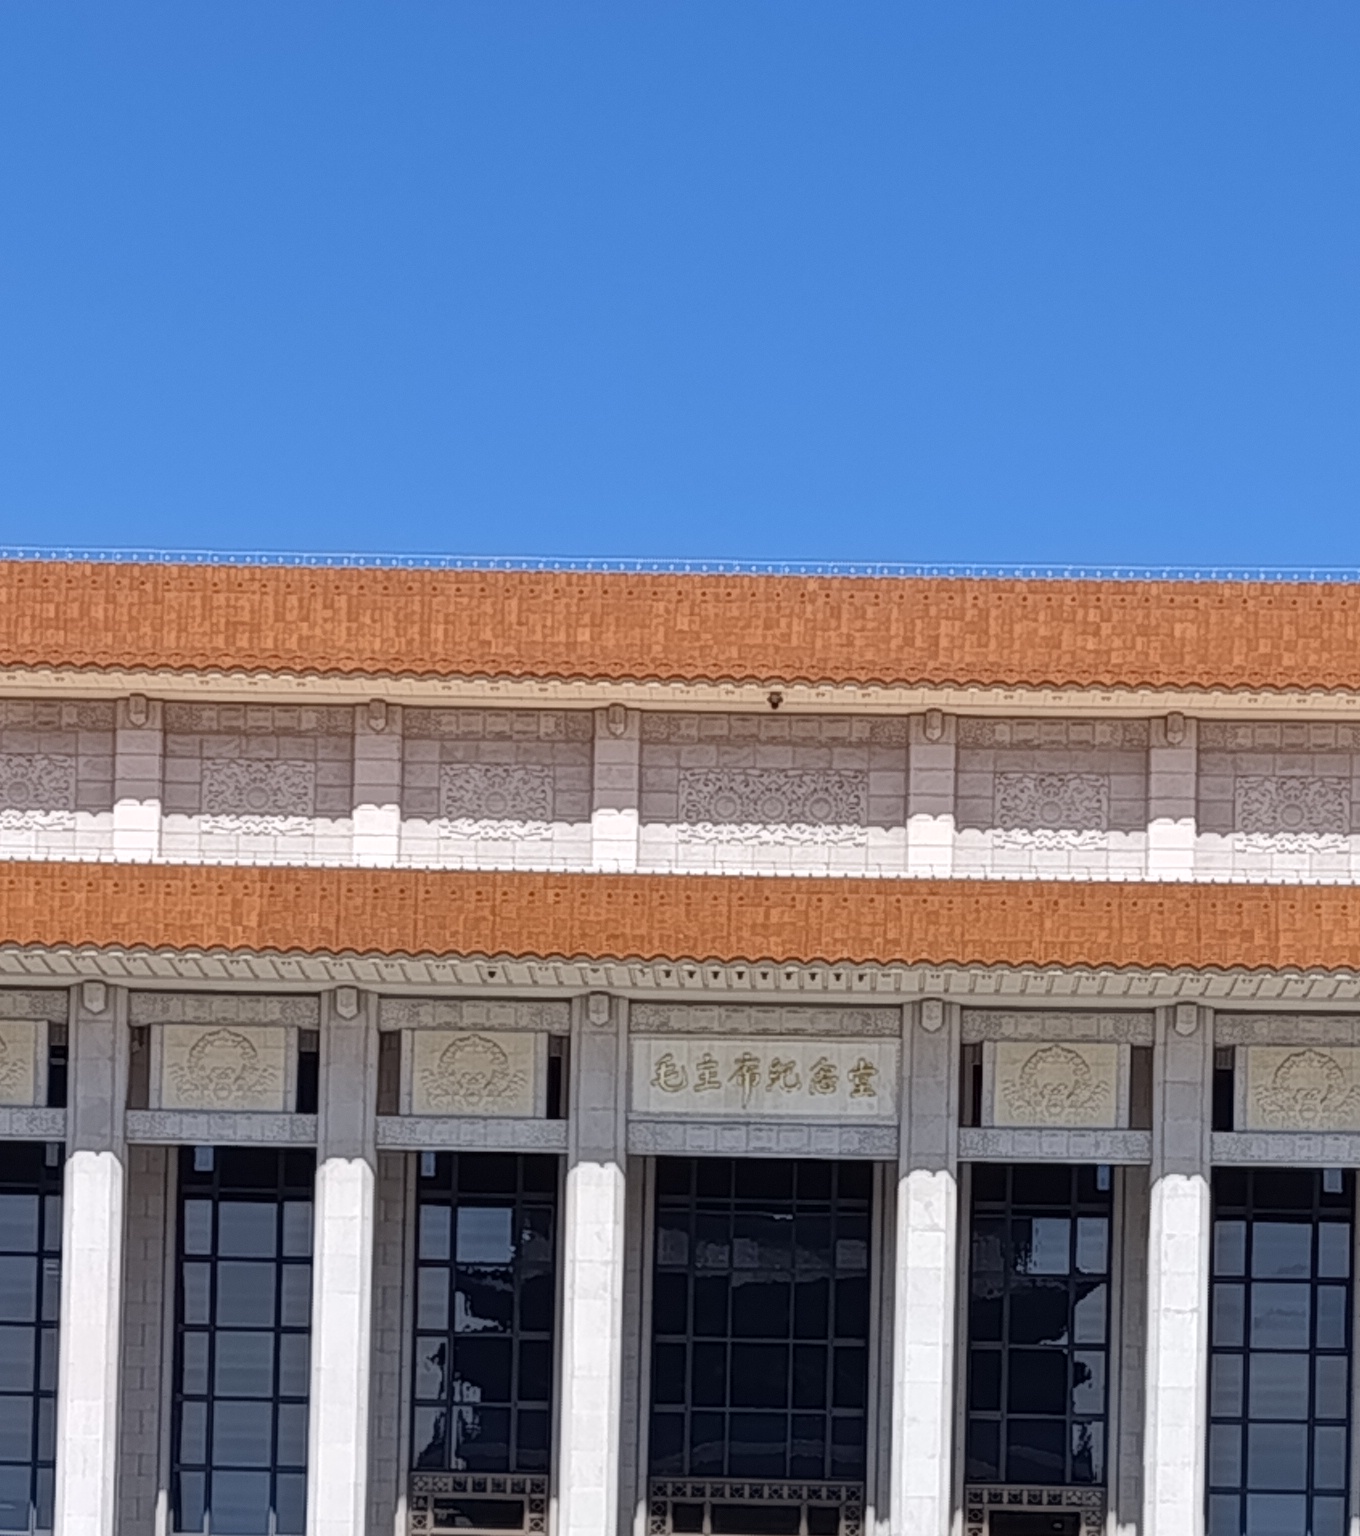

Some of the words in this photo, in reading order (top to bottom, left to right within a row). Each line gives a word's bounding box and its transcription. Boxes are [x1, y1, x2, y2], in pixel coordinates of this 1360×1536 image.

[650, 1052, 878, 1110] 毛主席纪念堂
